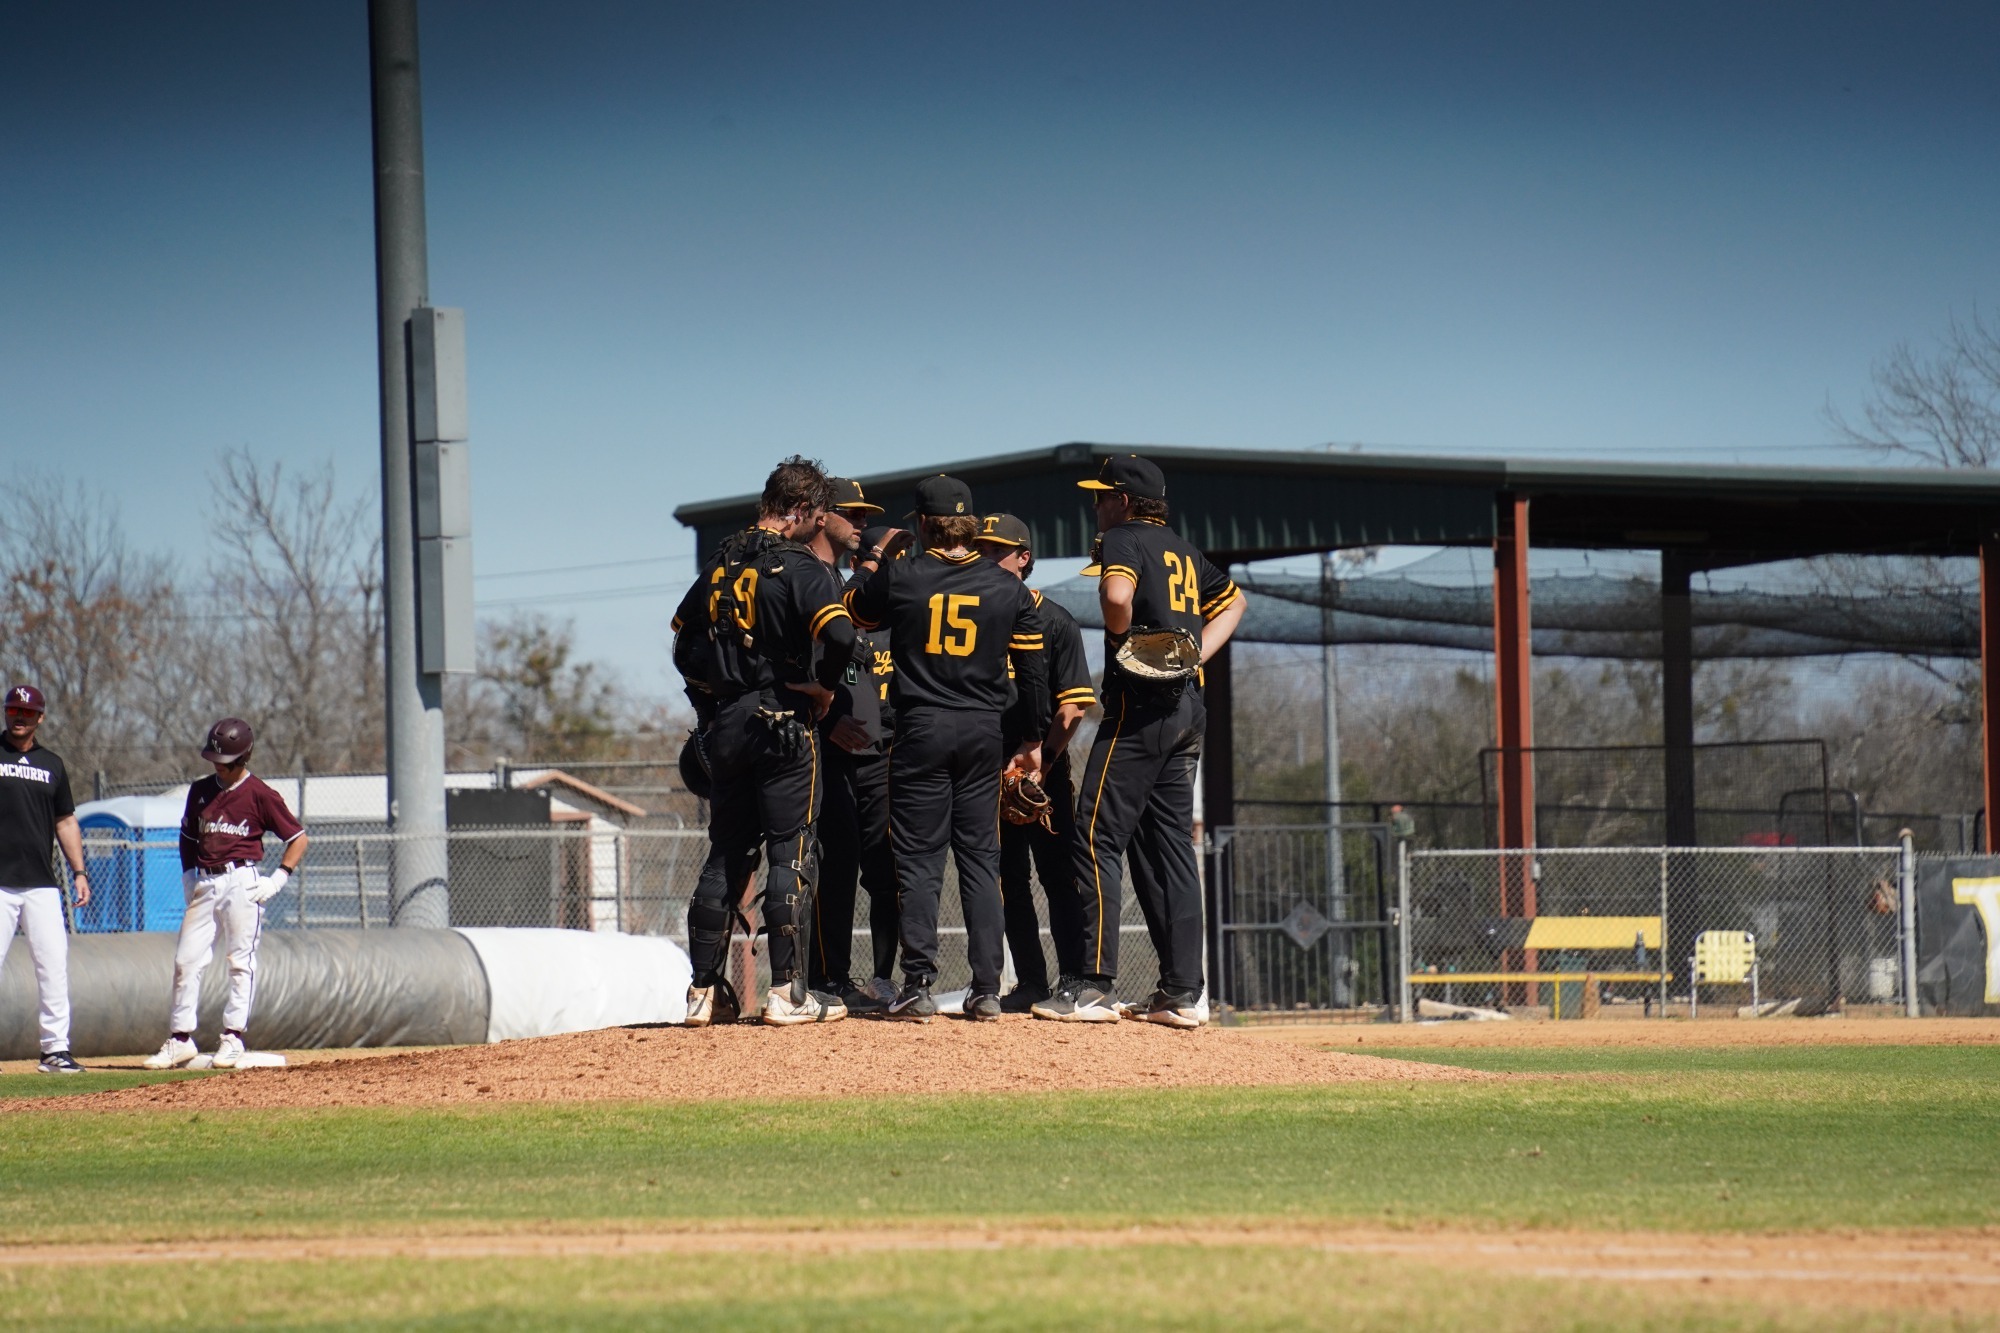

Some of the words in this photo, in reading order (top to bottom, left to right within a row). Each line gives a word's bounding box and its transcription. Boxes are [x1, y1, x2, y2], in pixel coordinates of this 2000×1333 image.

[983, 517, 999, 532] T
[1163, 551, 1200, 615] 24
[924, 593, 981, 657] 15
[0, 763, 51, 784] MCMURRY
[198, 814, 250, 837] Warhawks
